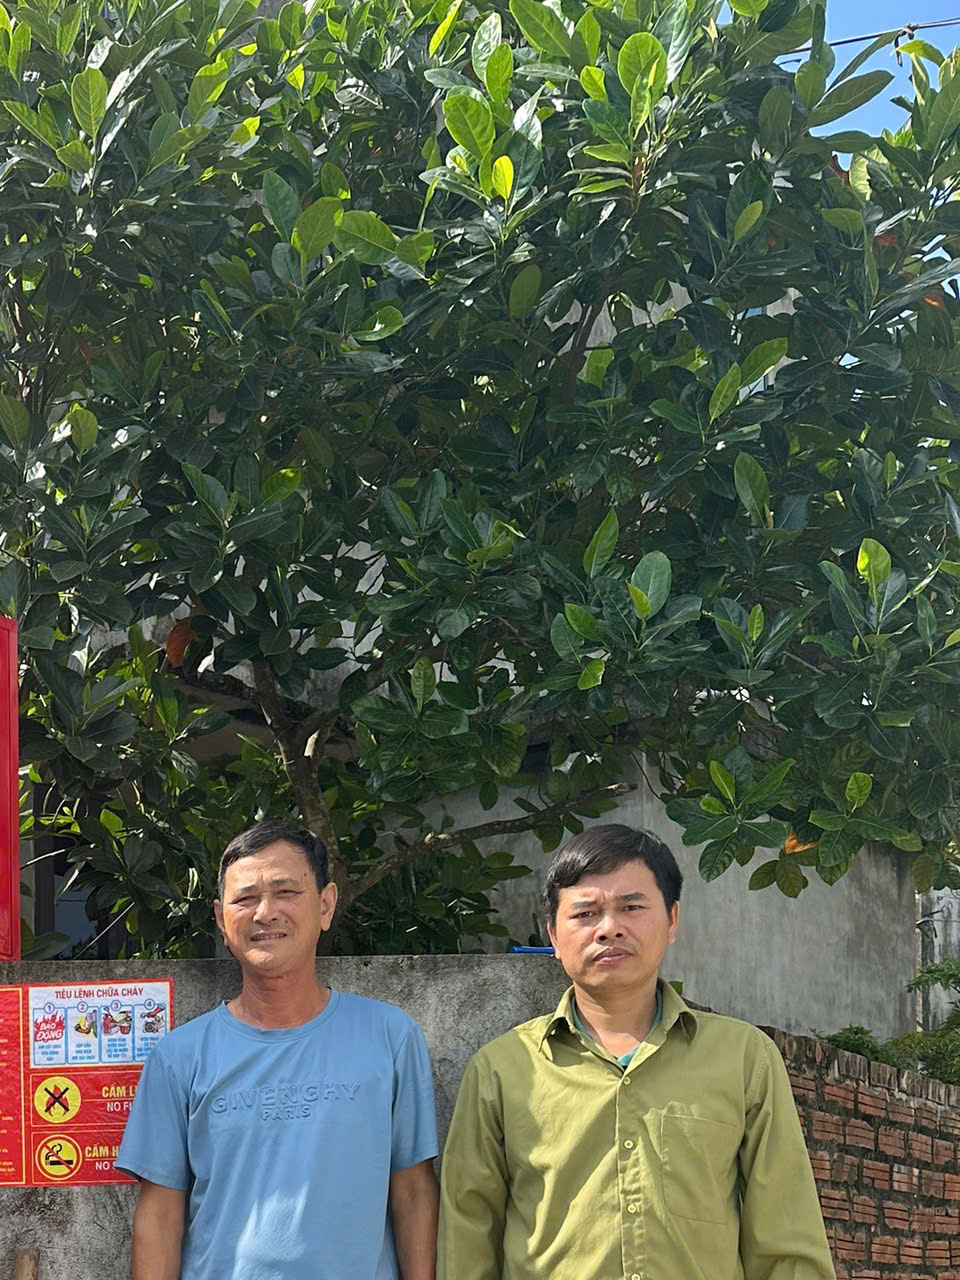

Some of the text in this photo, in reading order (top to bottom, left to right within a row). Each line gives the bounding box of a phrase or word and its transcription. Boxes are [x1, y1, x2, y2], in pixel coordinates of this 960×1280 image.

[210, 1082, 361, 1114] GIVENCHY
[106, 1101, 132, 1112] NO FI
[262, 1105, 311, 1121] PARIS
[95, 1161, 110, 1171] NO
